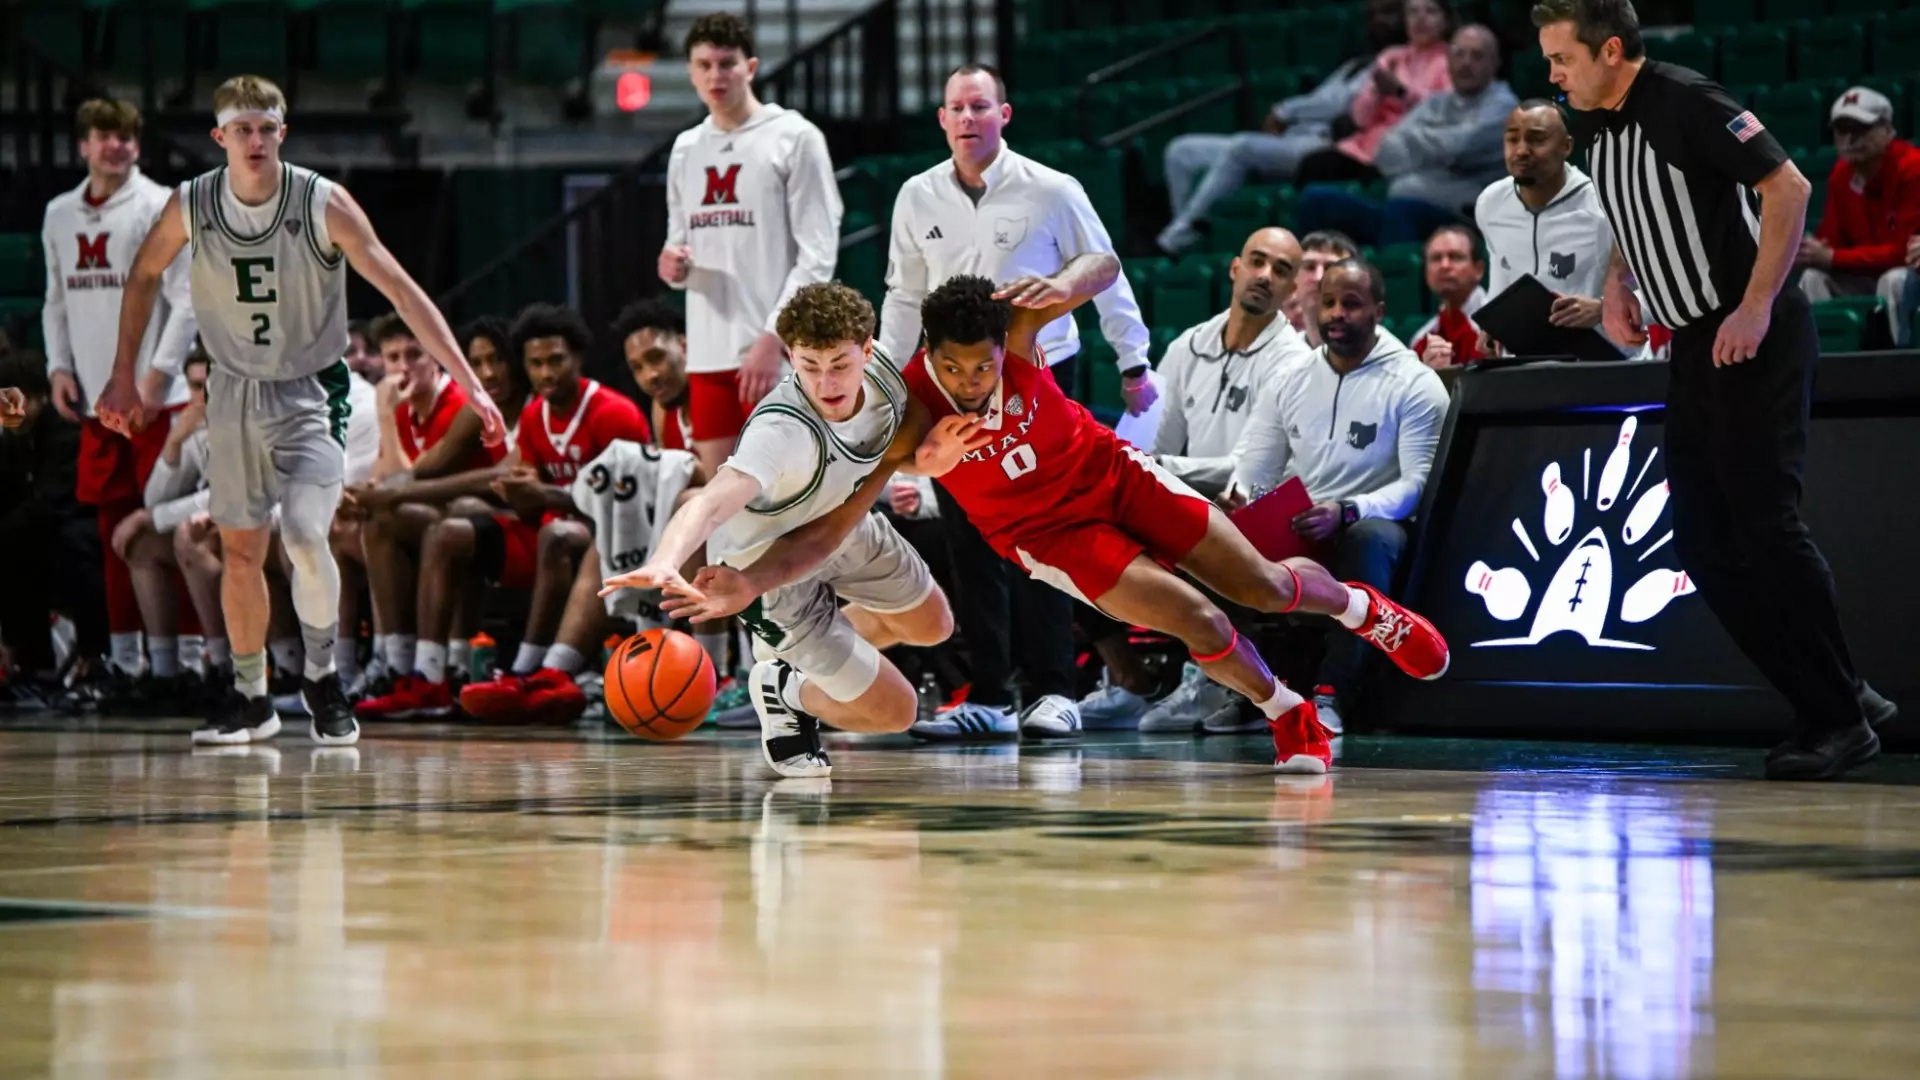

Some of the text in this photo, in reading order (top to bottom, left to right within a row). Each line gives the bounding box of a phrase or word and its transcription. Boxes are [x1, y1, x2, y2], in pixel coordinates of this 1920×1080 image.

[701, 163, 742, 206] M
[690, 209, 755, 230] BASKETBALL
[75, 231, 112, 271] M
[231, 256, 277, 303] E
[251, 313, 270, 346] 2
[961, 396, 1039, 463] MIAMI
[1000, 442, 1037, 481] 0
